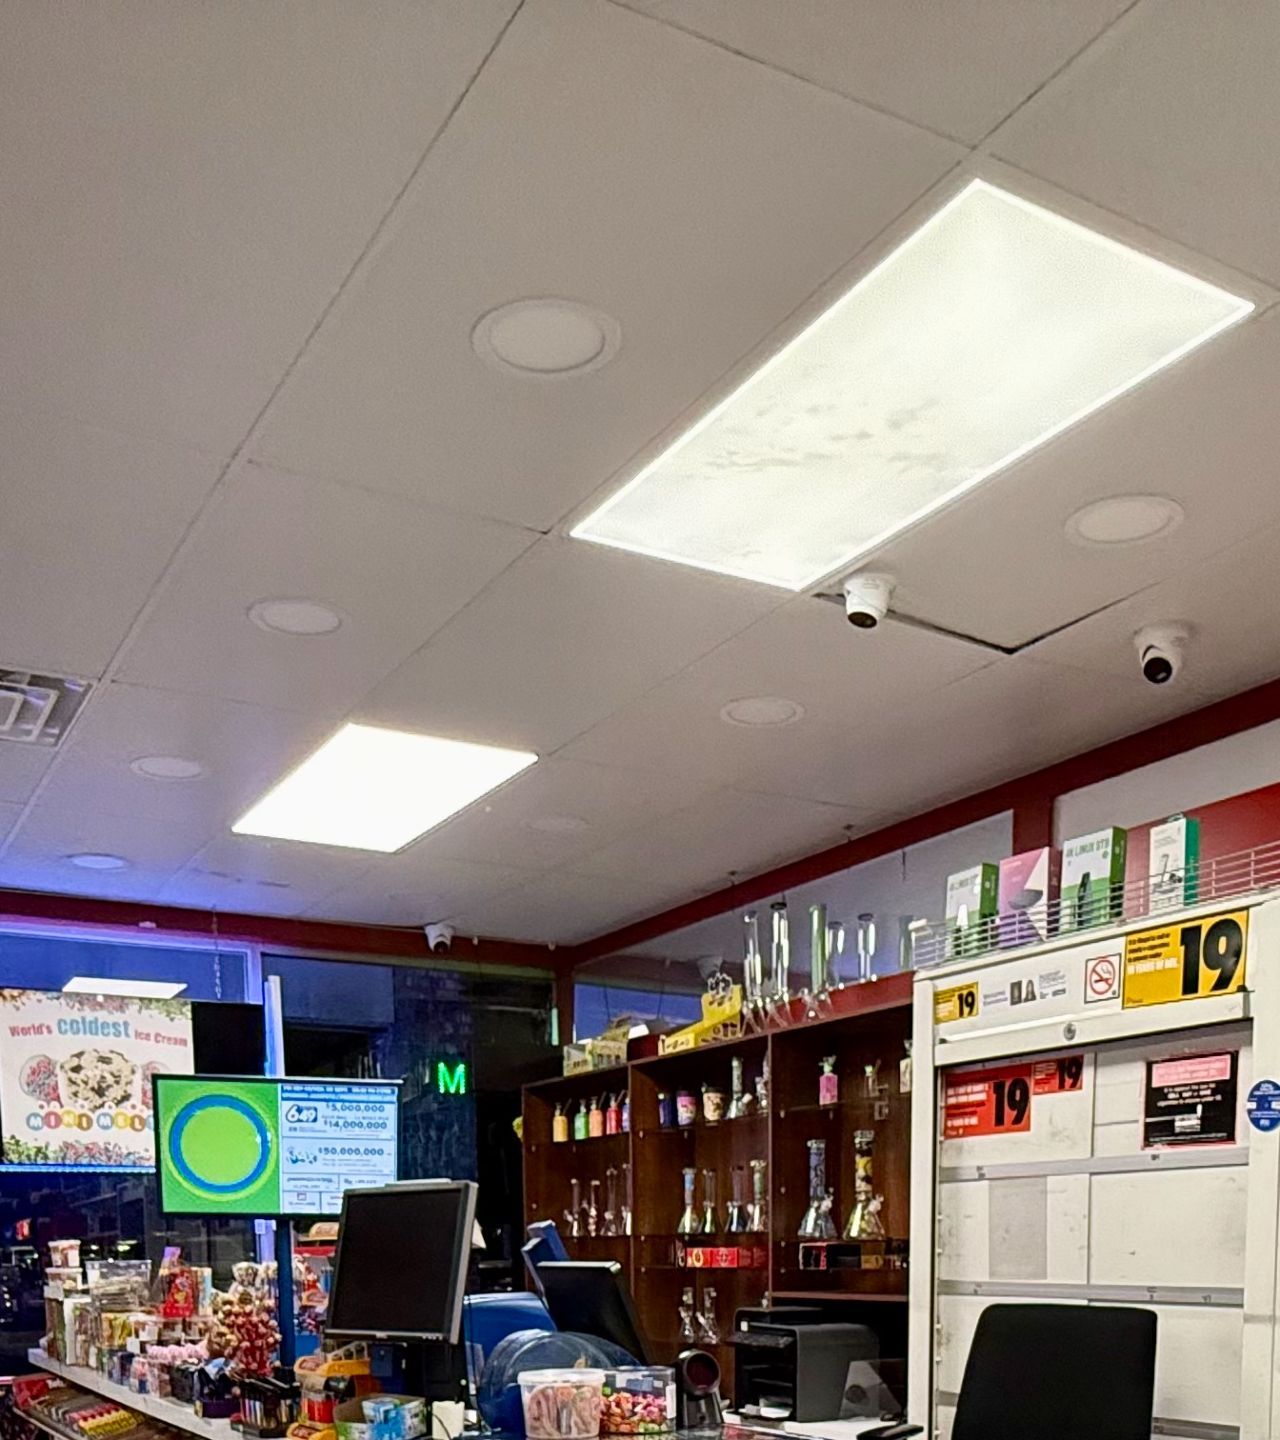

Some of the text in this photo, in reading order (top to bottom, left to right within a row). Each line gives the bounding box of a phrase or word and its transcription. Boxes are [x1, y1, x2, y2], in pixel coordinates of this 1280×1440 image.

[1180, 918, 1243, 996] 19
[958, 991, 976, 1018] 19
[8, 1016, 188, 1047] World's coldest Ice Cream
[1057, 1055, 1084, 1089] 19
[993, 1078, 1030, 1127] 19
[26, 1109, 93, 1131] MINI
